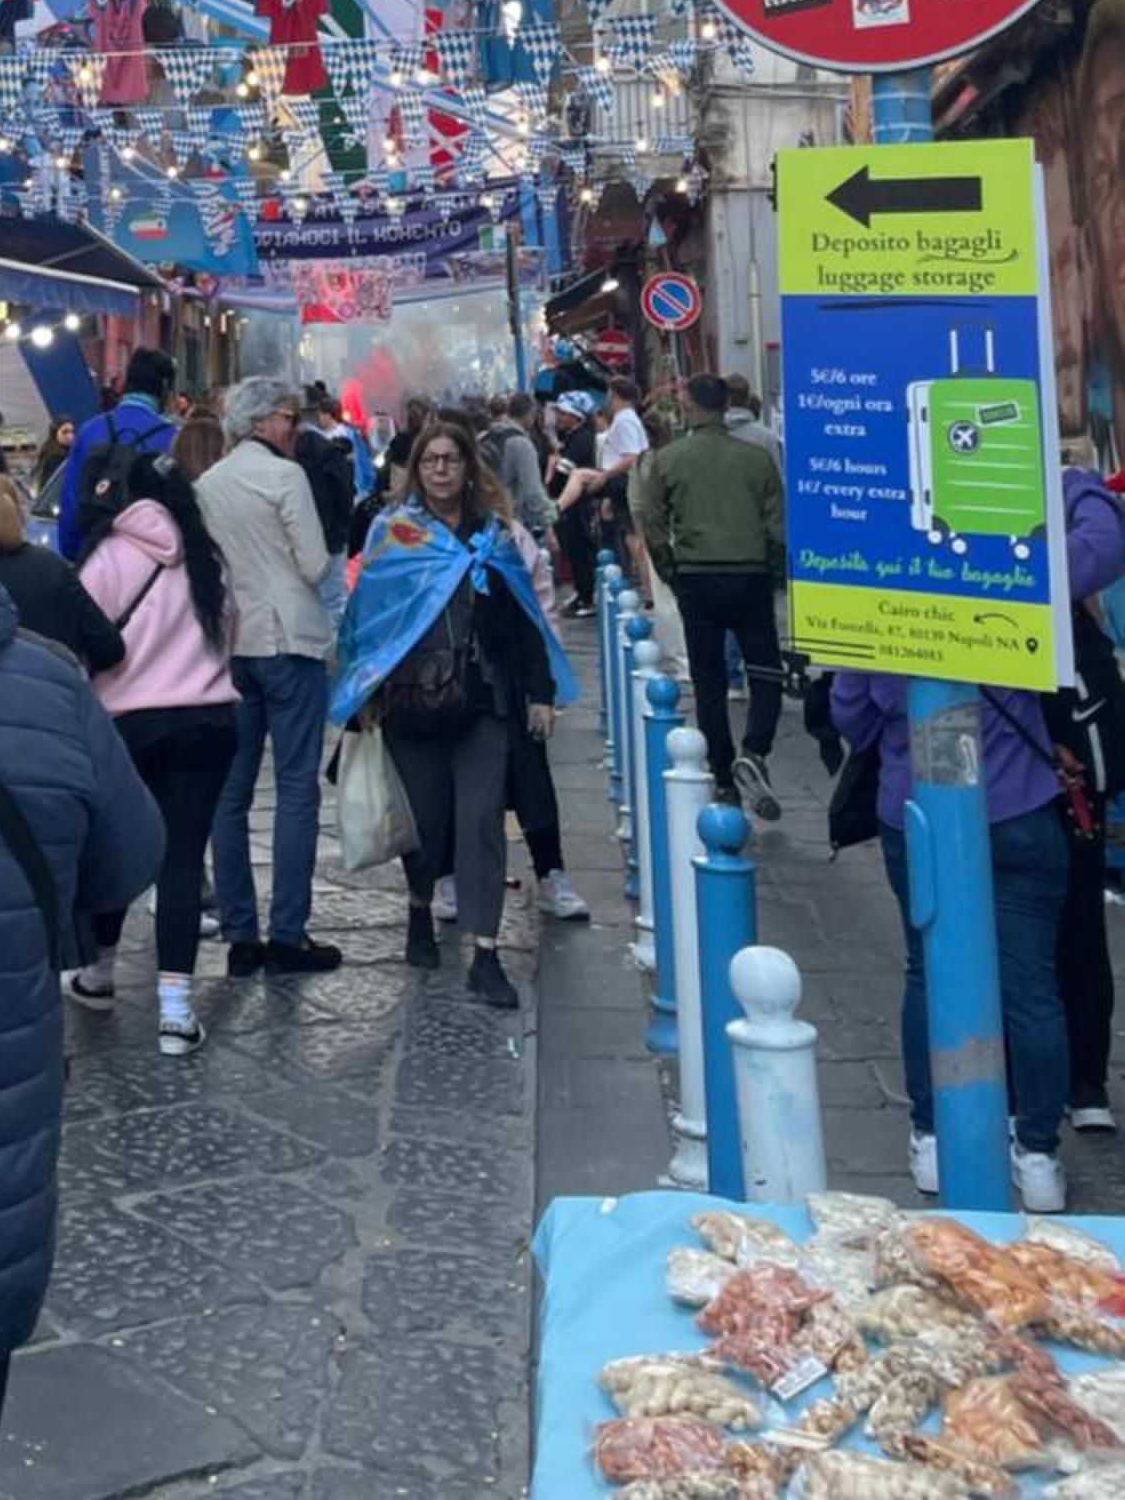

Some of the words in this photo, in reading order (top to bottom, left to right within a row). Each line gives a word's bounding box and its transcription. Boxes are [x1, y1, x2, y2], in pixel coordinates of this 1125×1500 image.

[345, 226, 368, 245] IL
[812, 232, 910, 258] Deposito
[916, 229, 1002, 258] bagagli
[818, 265, 906, 293] luggage
[912, 269, 996, 293] storage
[810, 368, 845, 385] 5€/6
[849, 373, 878, 386] ore
[797, 393, 862, 416] 1€/ogni
[864, 400, 893, 413] ora
[824, 422, 867, 437] extra
[844, 458, 888, 476] hours
[823, 484, 865, 501] every
[867, 486, 907, 500] extra
[830, 503, 869, 521] hour
[995, 637, 1020, 653] NA
